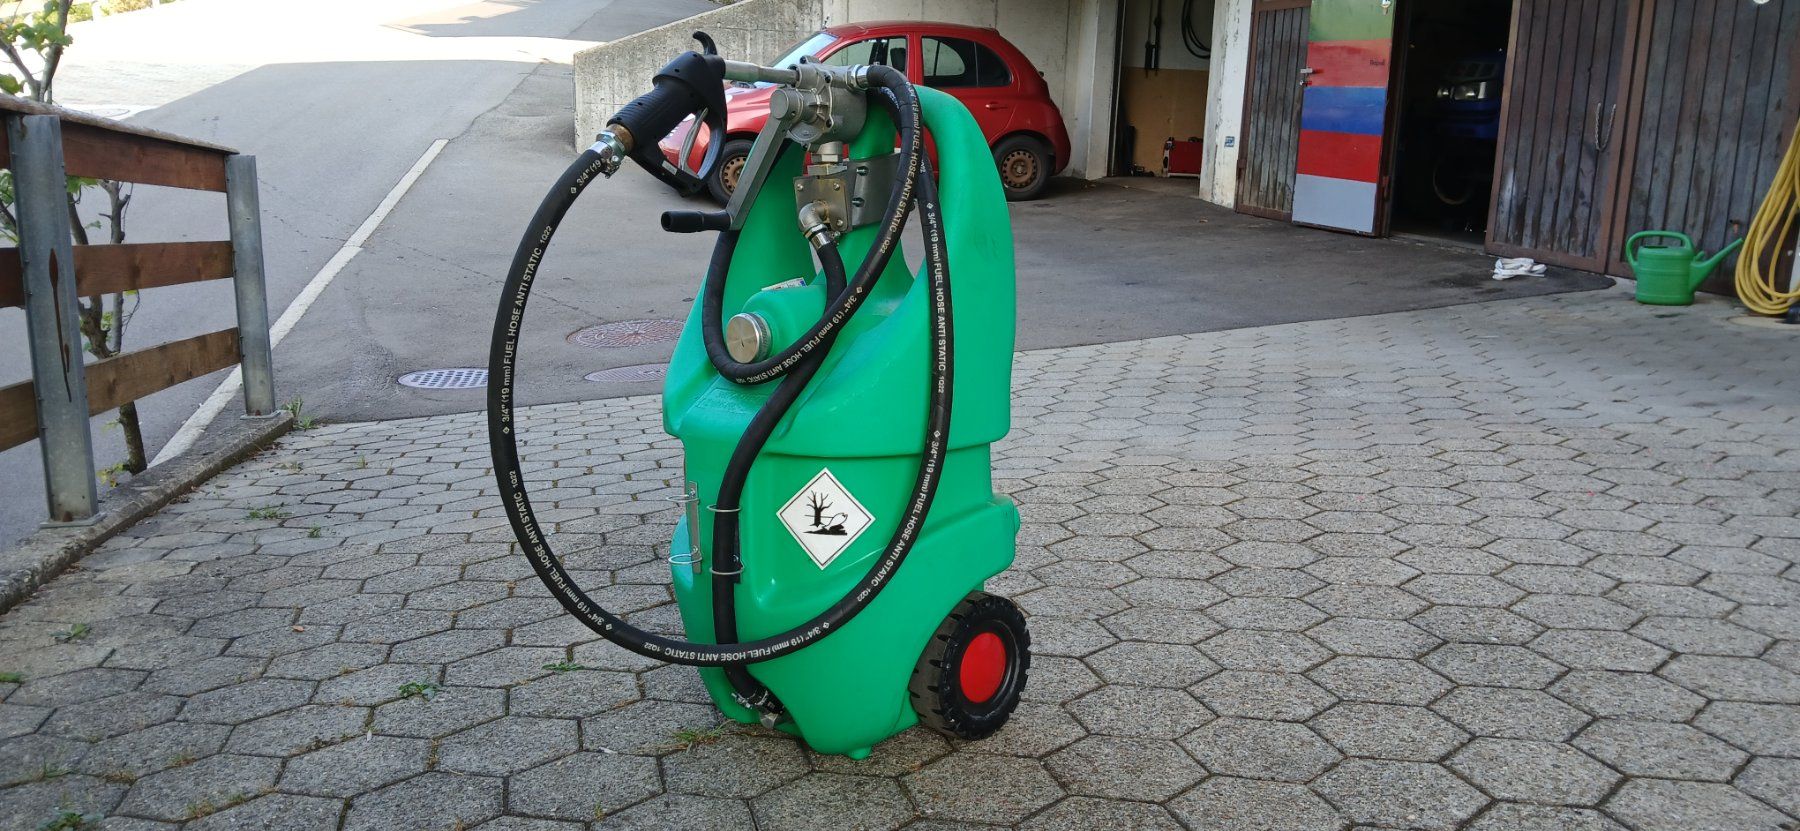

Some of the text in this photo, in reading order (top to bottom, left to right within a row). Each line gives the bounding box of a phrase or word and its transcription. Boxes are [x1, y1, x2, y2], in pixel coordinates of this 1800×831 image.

[912, 129, 920, 150] FUEL
[907, 152, 918, 178] HOSE
[577, 169, 590, 186] 3/4"
[901, 177, 914, 201] ANTI
[889, 200, 907, 233] STATIC
[927, 212, 937, 229] 3/4"
[930, 229, 939, 243] (19
[931, 243, 940, 262] mm)
[523, 247, 542, 282] STATIC
[934, 262, 943, 287] FUEL
[515, 282, 529, 307] ANTI
[936, 288, 945, 315] HOSE
[508, 308, 521, 337] HOSE
[833, 311, 845, 324] (19
[938, 315, 946, 338] ANTI
[503, 339, 515, 364] FUEL
[800, 336, 820, 352] FUEL
[782, 351, 803, 368] HOSE
[938, 339, 947, 371] STATIC
[503, 366, 512, 387] mm)
[767, 364, 784, 377] ANTI
[501, 388, 509, 403] (19
[502, 404, 510, 422] 3/4"
[931, 440, 940, 459] 3/4"
[513, 491, 530, 524] STATIC
[913, 492, 927, 516] FUEL
[524, 523, 539, 544] ANTI
[901, 515, 917, 541] HOSE
[533, 544, 553, 569] HOSE
[892, 539, 906, 561] ANTI
[549, 568, 566, 590] FUEL
[871, 559, 894, 587] STATIC
[587, 613, 605, 626] 3/4"
[805, 627, 822, 641] 3/4"
[664, 647, 695, 660] STATIC
[697, 653, 719, 661] ANTI
[721, 651, 747, 661] HOSE
[749, 647, 771, 659] FUEL
